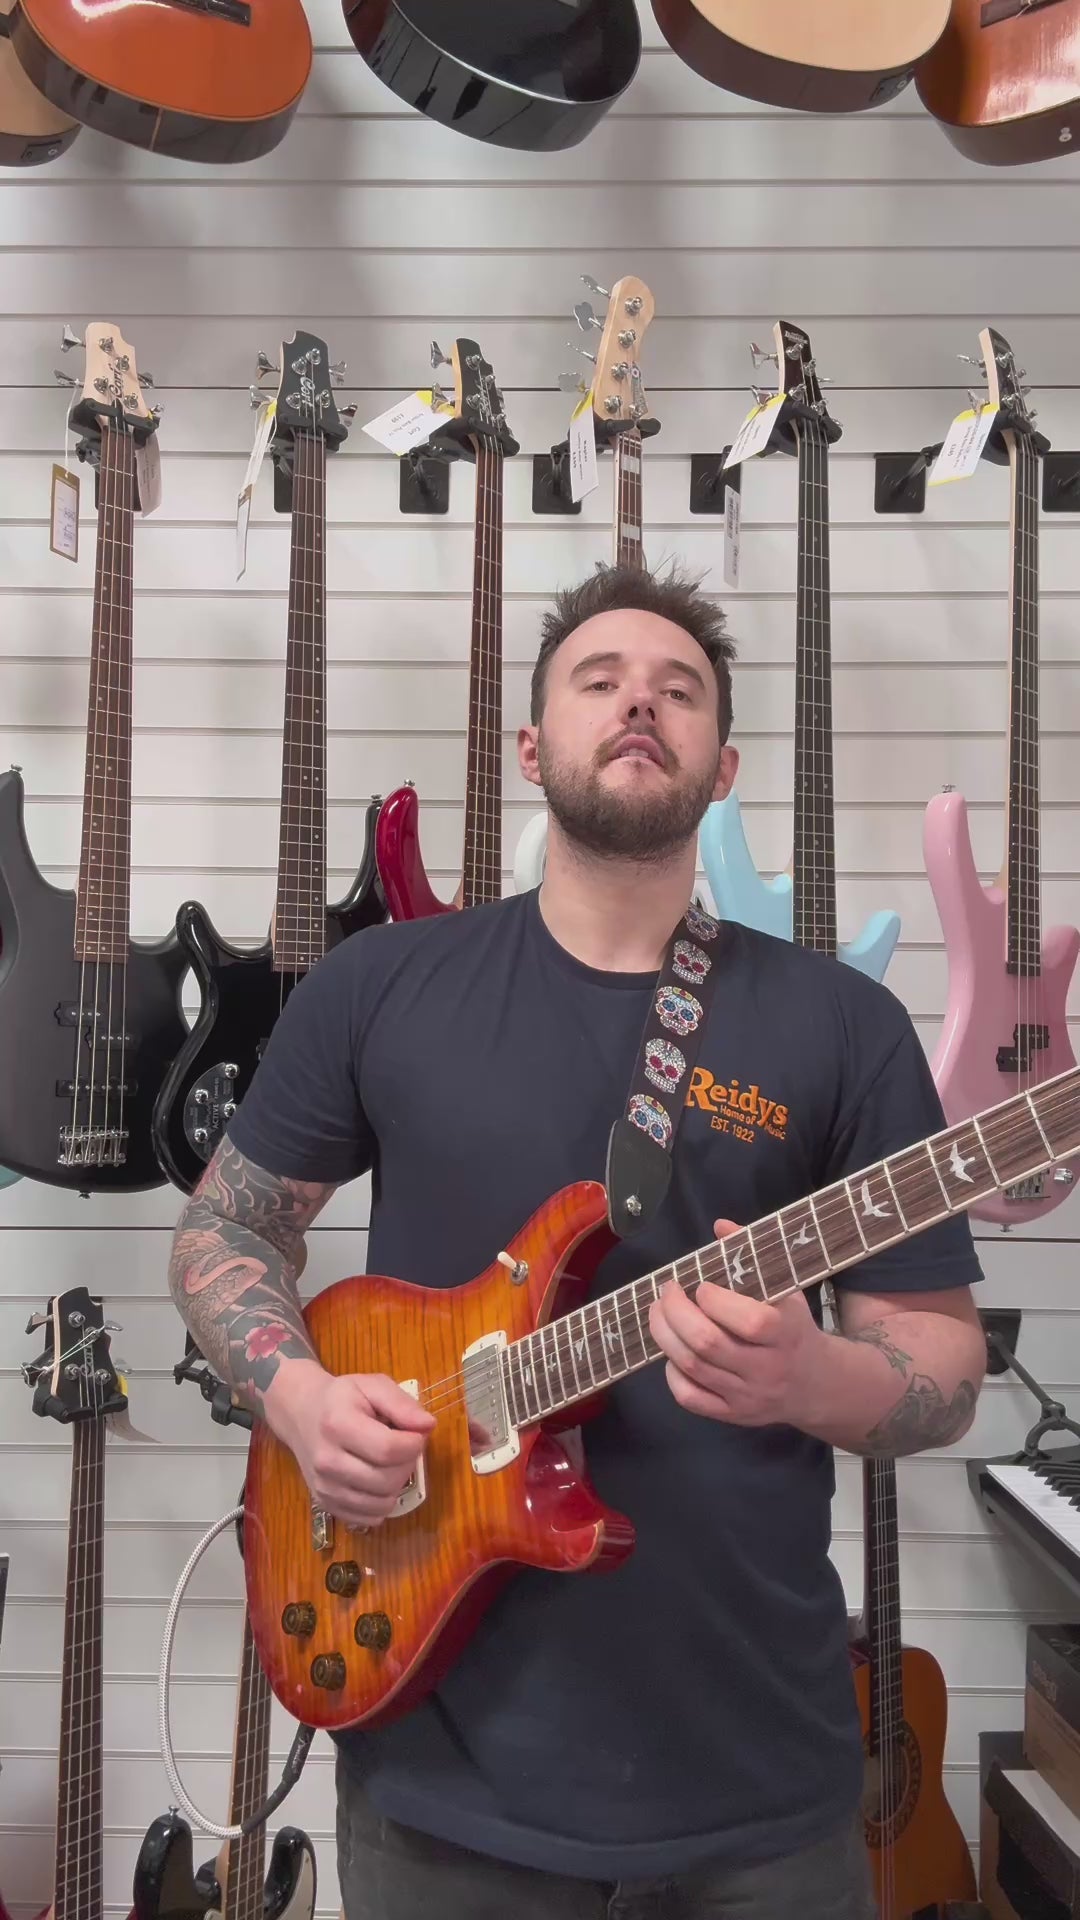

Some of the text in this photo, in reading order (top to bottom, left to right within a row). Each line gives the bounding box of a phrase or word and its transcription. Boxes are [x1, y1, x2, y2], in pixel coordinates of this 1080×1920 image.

[684, 1066, 788, 1127] Reidys
[710, 1116, 754, 1143] EST. 1922
[720, 1105, 786, 1139] Home of Music
